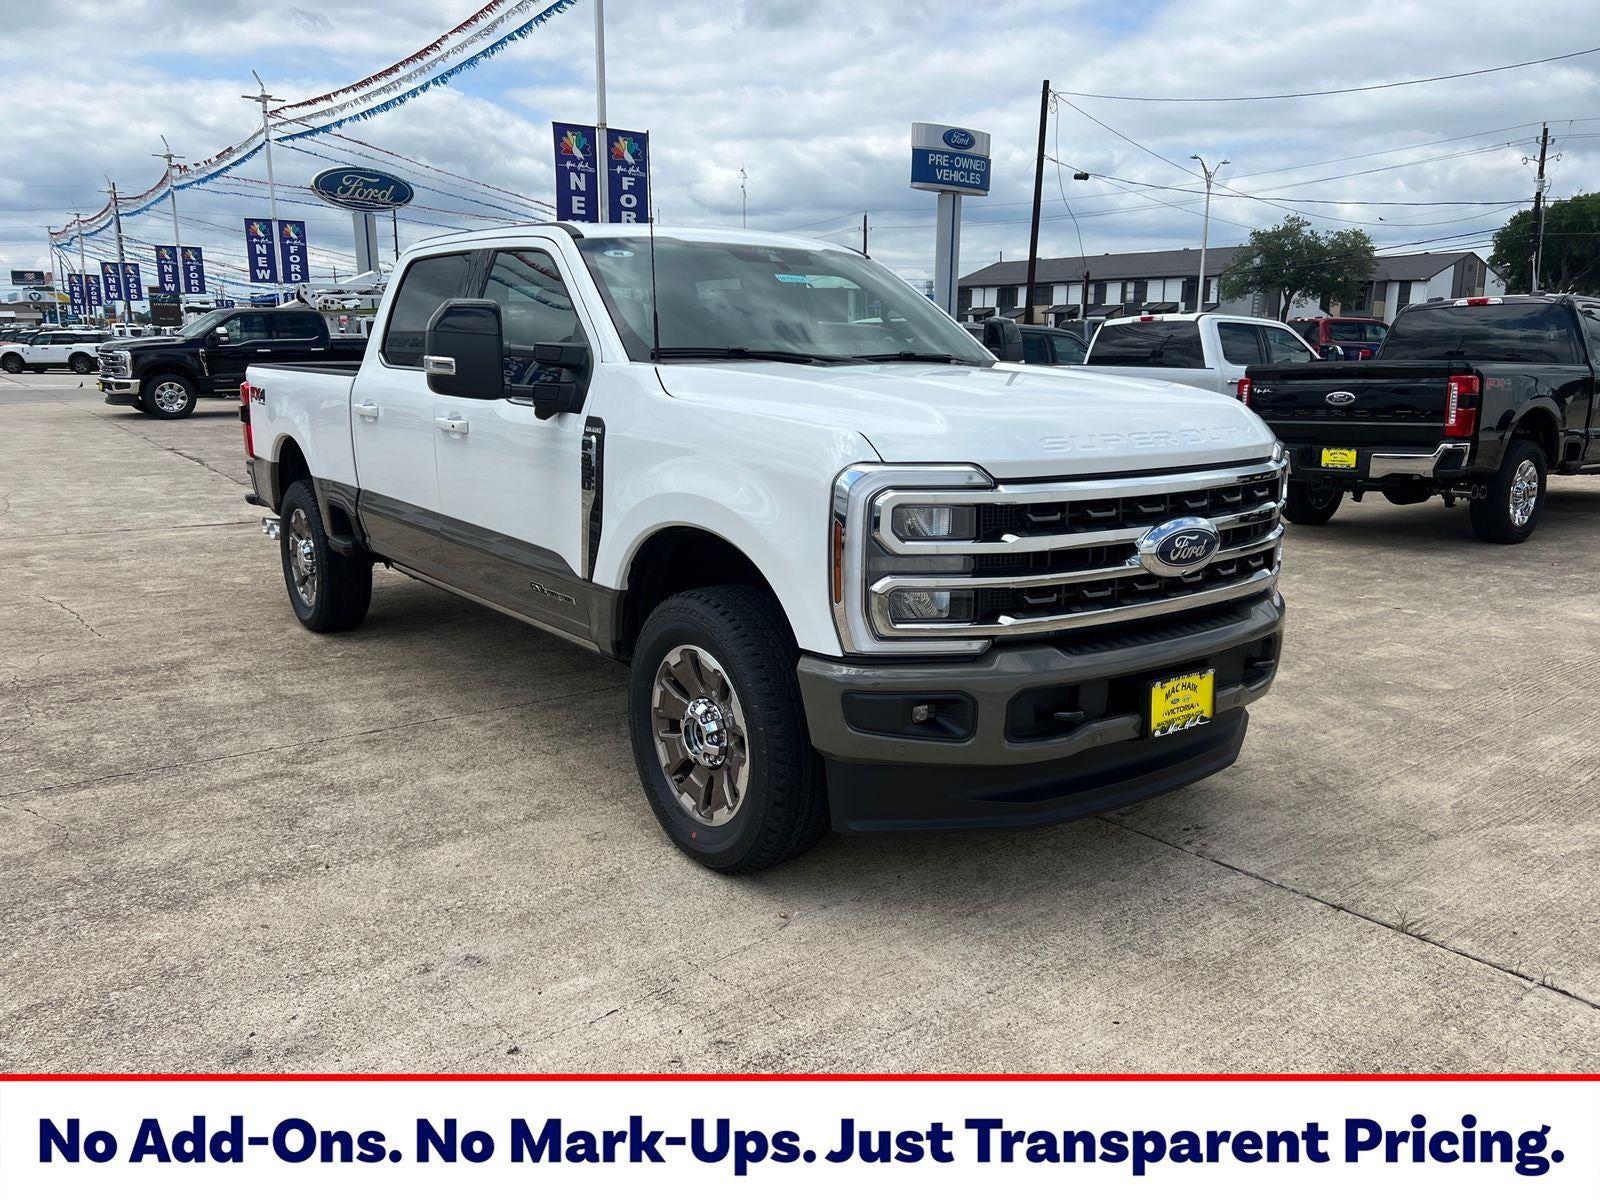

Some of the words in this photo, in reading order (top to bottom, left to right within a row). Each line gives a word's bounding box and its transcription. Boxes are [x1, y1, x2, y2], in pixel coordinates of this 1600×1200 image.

[950, 132, 970, 146] Ford
[928, 153, 986, 172] PRE-OWNED
[337, 174, 395, 203] Ford
[935, 168, 981, 185] VEHICLES
[568, 172, 590, 222] NE
[255, 244, 271, 280] NEW
[289, 245, 301, 281] FORD
[108, 277, 119, 299] NEW
[129, 278, 138, 300] FORD
[163, 264, 175, 292] NEW
[189, 265, 200, 293] FORD
[1040, 429, 1179, 453] SUPER
[1170, 535, 1207, 561] Ford
[1165, 684, 1180, 701] MAC
[1181, 682, 1198, 693] HAIK
